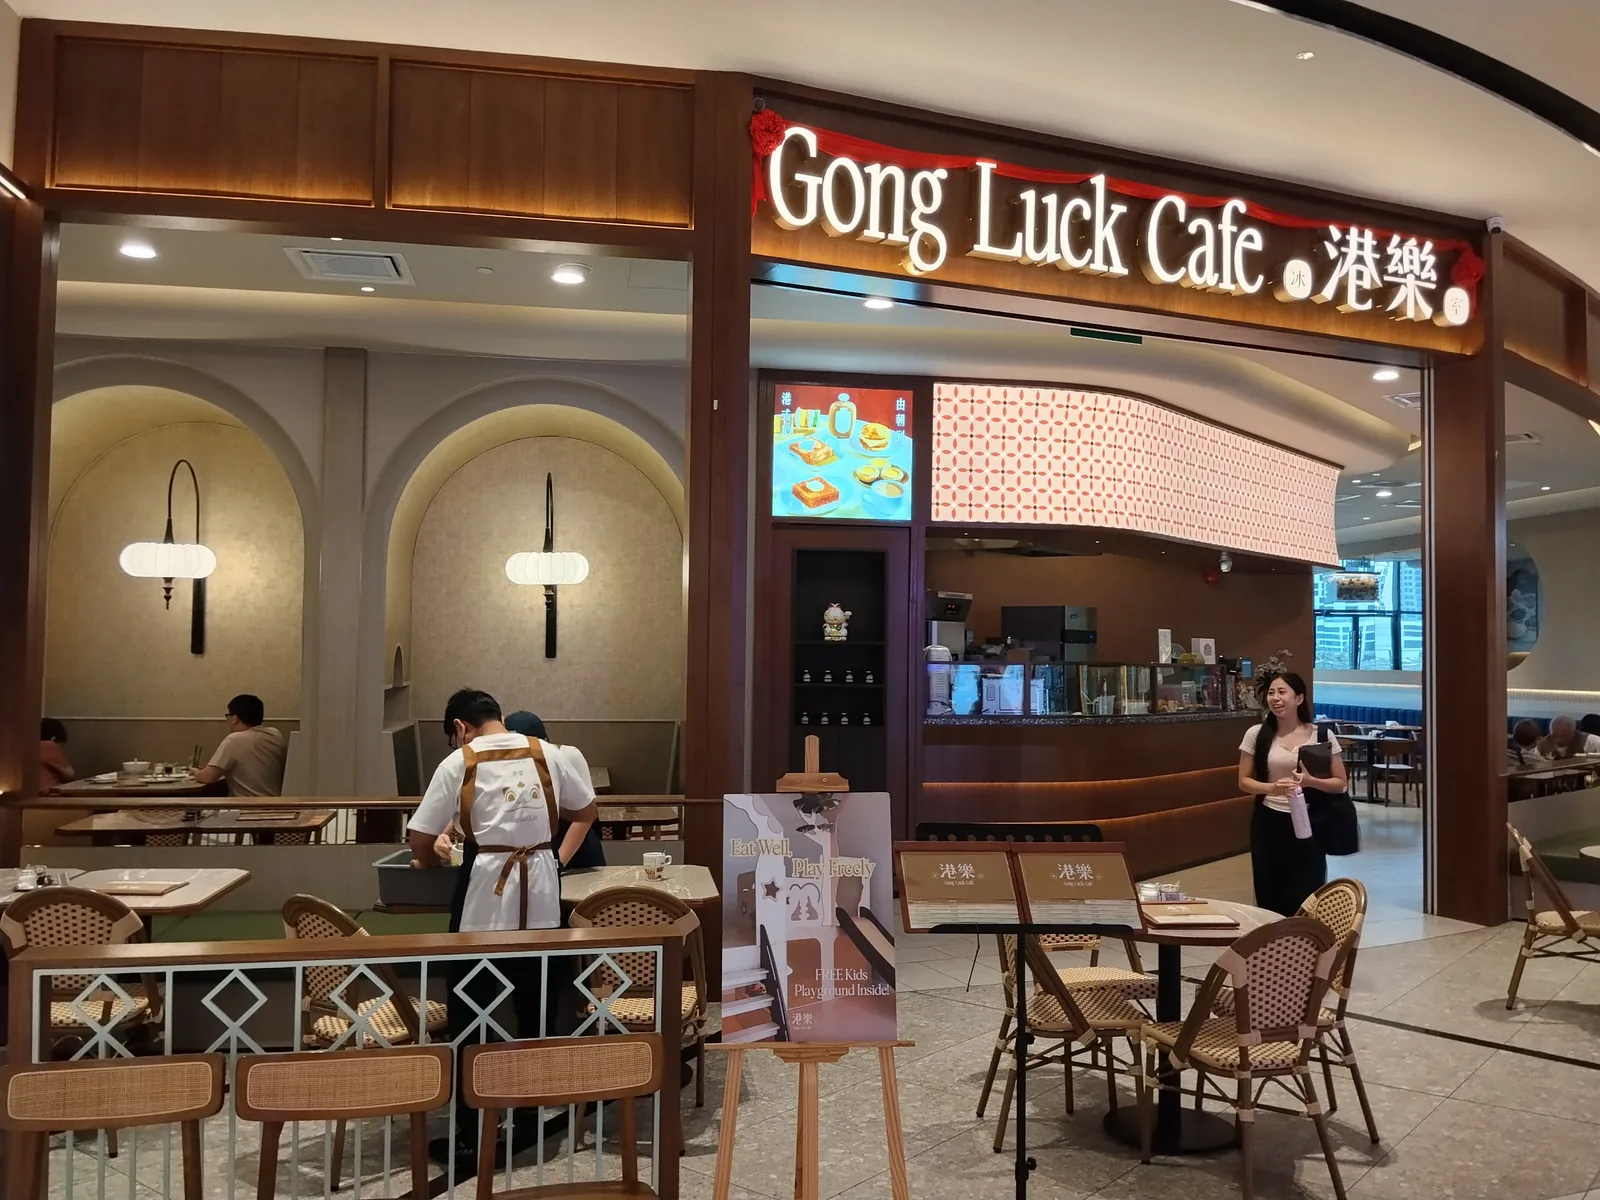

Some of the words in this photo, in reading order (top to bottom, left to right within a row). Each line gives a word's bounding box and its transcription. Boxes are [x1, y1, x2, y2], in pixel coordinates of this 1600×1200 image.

[768, 126, 948, 273] Gong
[973, 161, 1129, 277] Luck
[1147, 195, 1264, 294] Cafe
[1321, 224, 1437, 320] 港樂
[730, 838, 756, 857] Eat
[758, 838, 793, 858] Well,
[791, 858, 826, 880] Play
[828, 857, 876, 881] Freely
[939, 863, 975, 879] 港樂
[1057, 863, 1094, 880] 港樂
[815, 968, 843, 981] FREE
[845, 968, 868, 981] Kids
[794, 984, 855, 999] Playground
[857, 983, 890, 996] Inside!
